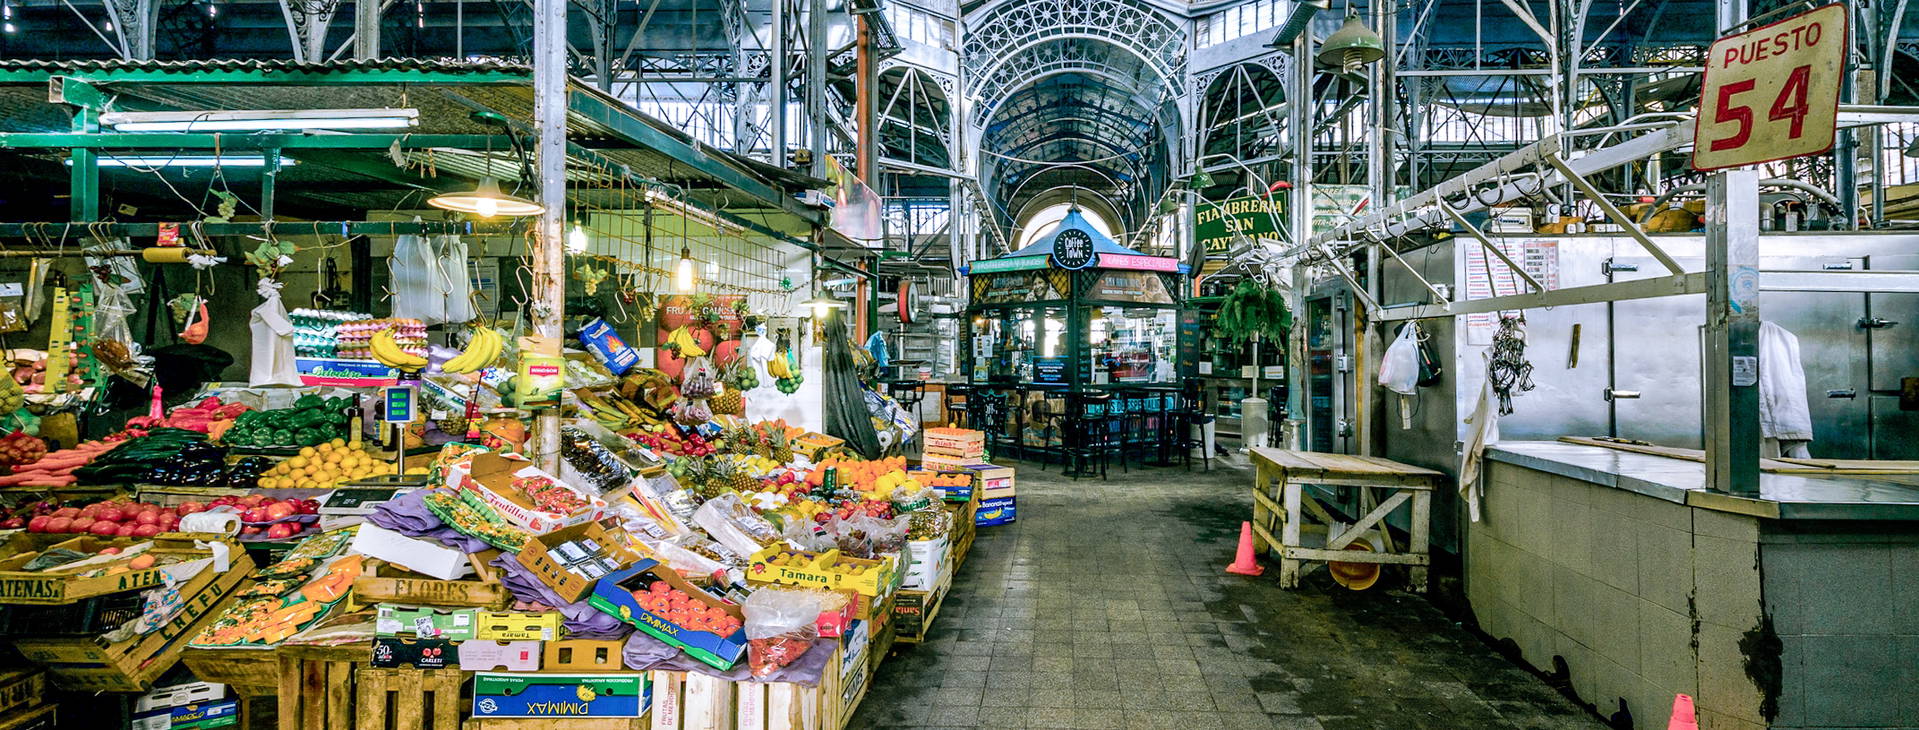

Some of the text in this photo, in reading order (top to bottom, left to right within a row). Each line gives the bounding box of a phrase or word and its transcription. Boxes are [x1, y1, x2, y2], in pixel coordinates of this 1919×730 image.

[1723, 22, 1822, 69] PUESTO
[1710, 65, 1812, 152] 54
[1225, 217, 1254, 232] SAN
[1064, 237, 1084, 248] Coffee
[780, 568, 828, 584] Tamara
[395, 579, 468, 600] FLORES
[640, 612, 679, 638] DIMIMAX
[527, 701, 588, 715] DIMIMAX
